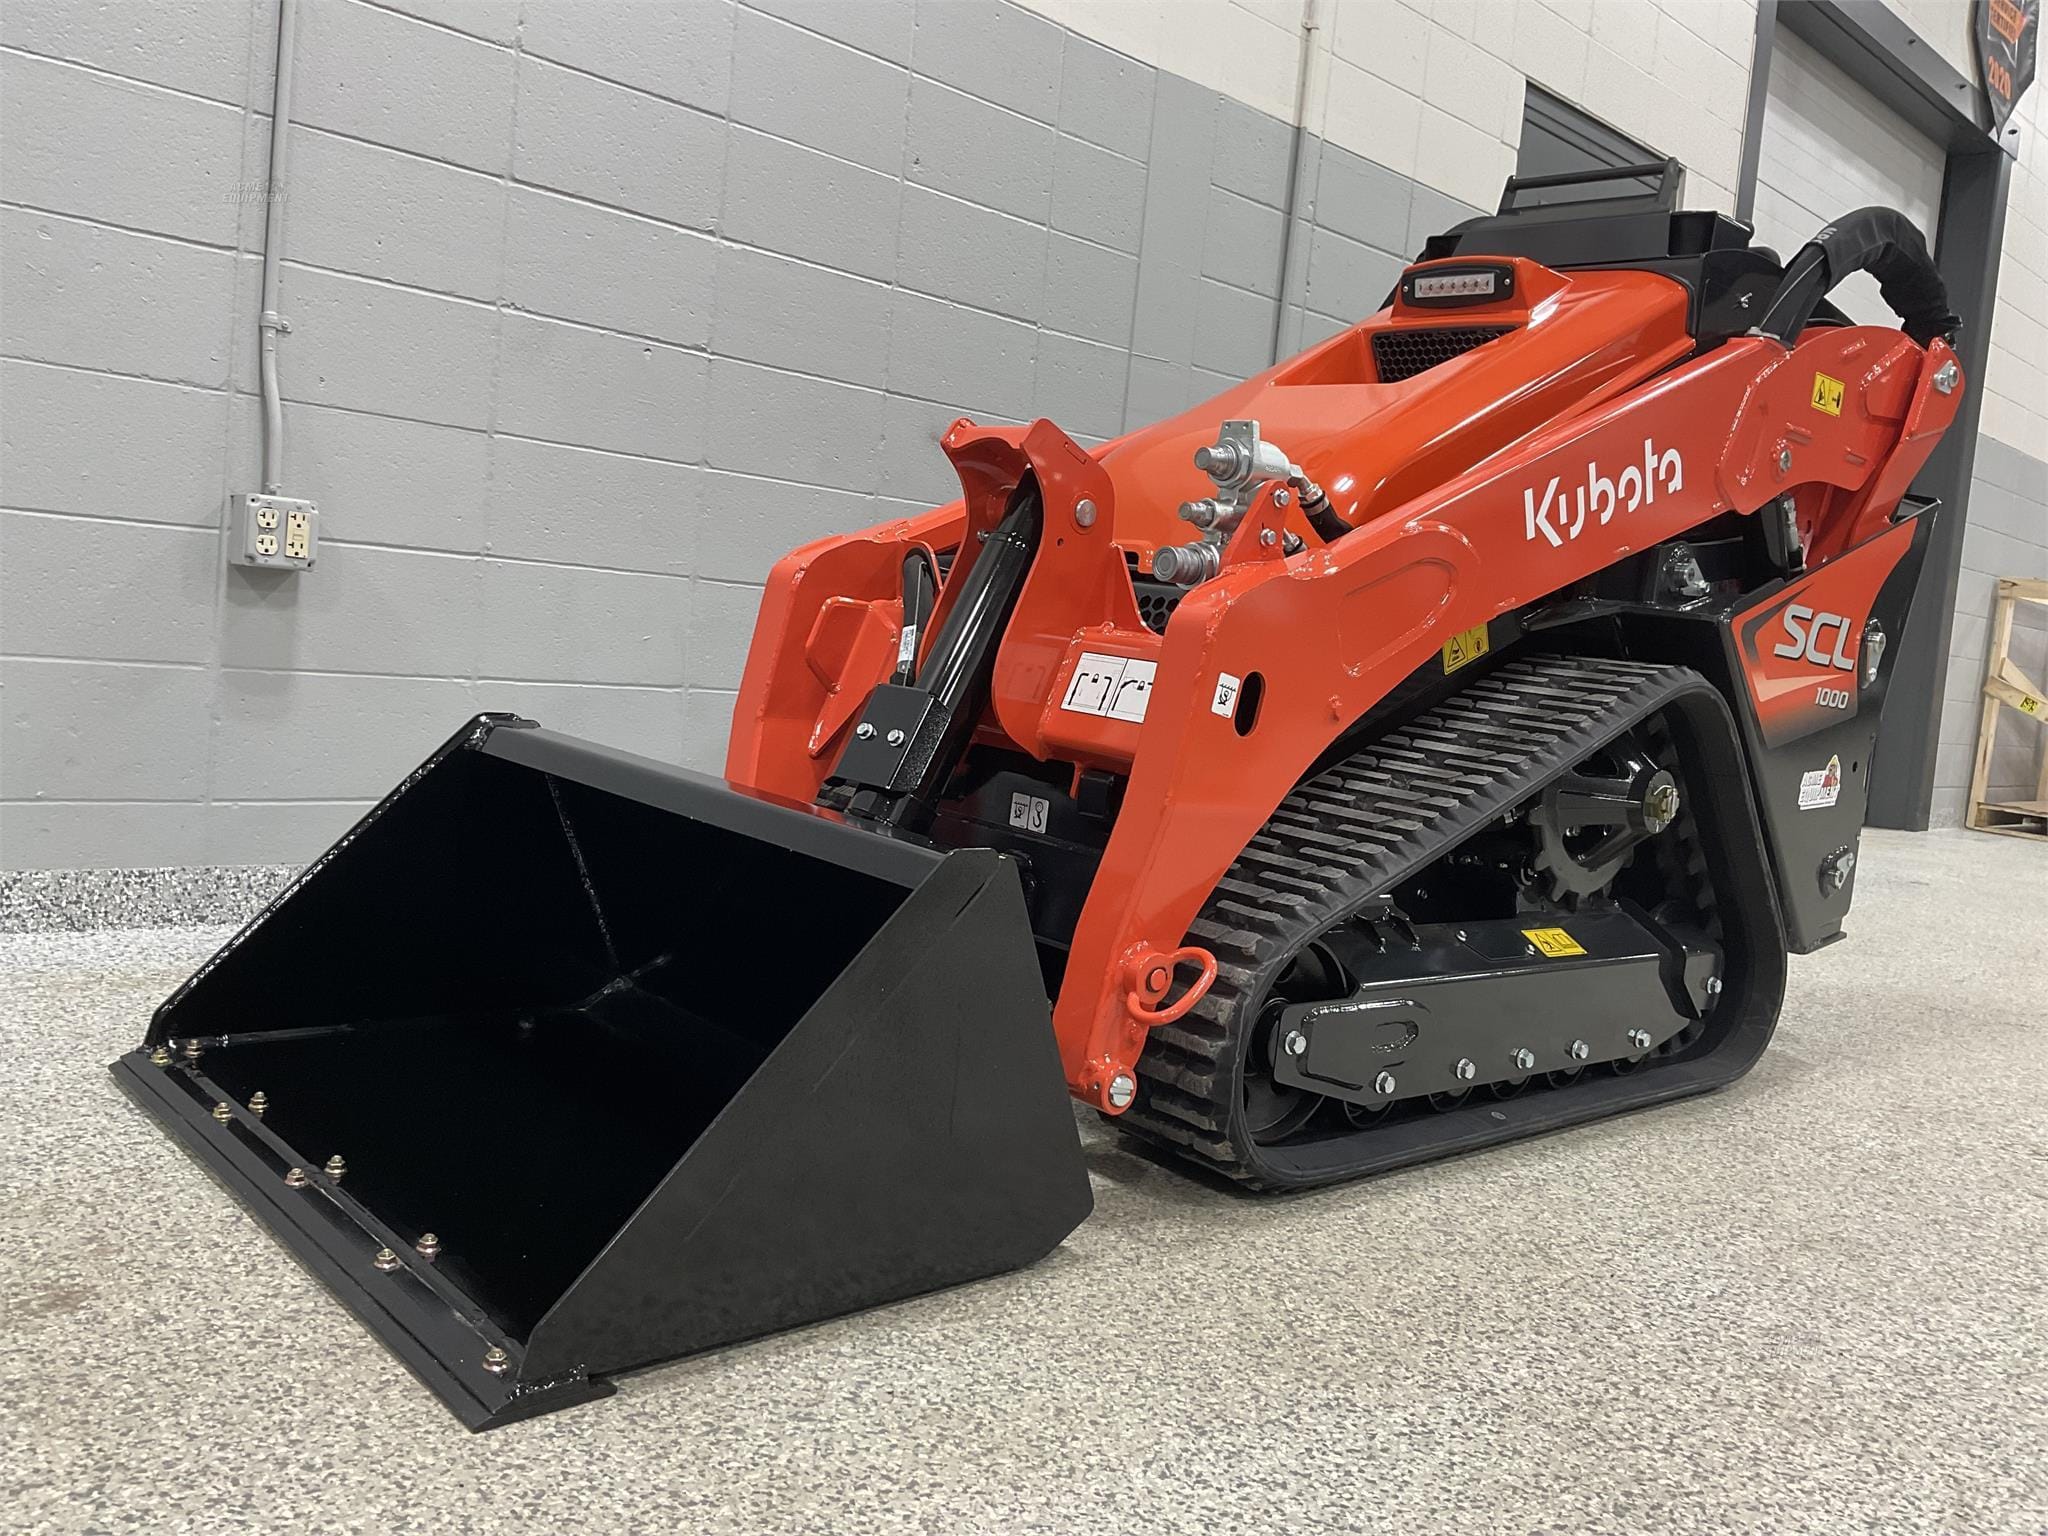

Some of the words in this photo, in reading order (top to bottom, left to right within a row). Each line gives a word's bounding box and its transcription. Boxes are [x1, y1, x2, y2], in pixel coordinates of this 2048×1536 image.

[1989, 55, 2011, 100] 2020
[1525, 438, 1682, 547] Kubota
[1774, 604, 1855, 671] SCL
[1815, 687, 1848, 709] 1000
